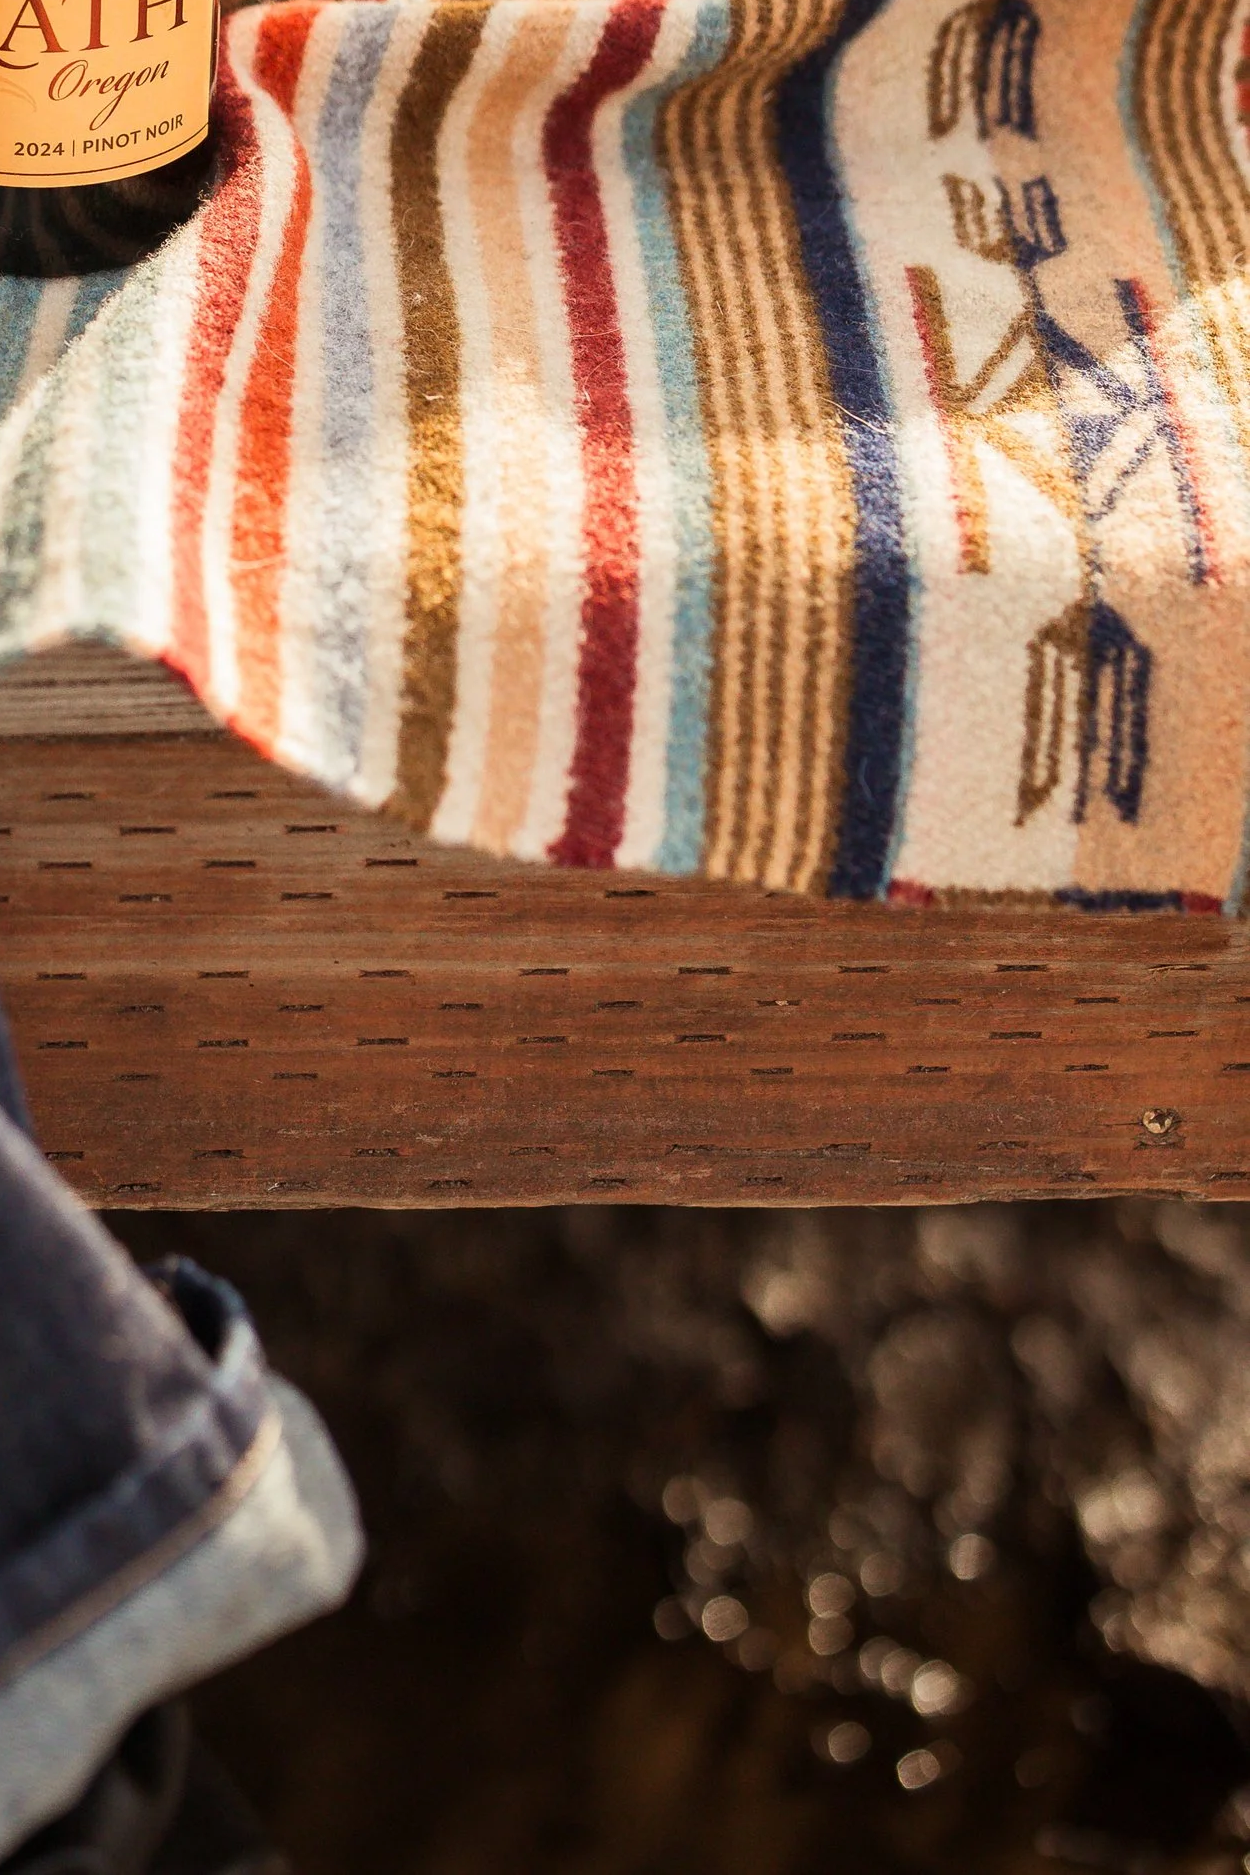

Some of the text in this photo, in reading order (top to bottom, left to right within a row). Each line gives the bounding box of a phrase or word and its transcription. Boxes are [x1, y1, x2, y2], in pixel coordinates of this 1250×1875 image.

[47, 58, 170, 131] Oregon
[13, 113, 184, 157] 2024 PINOT NOIR
